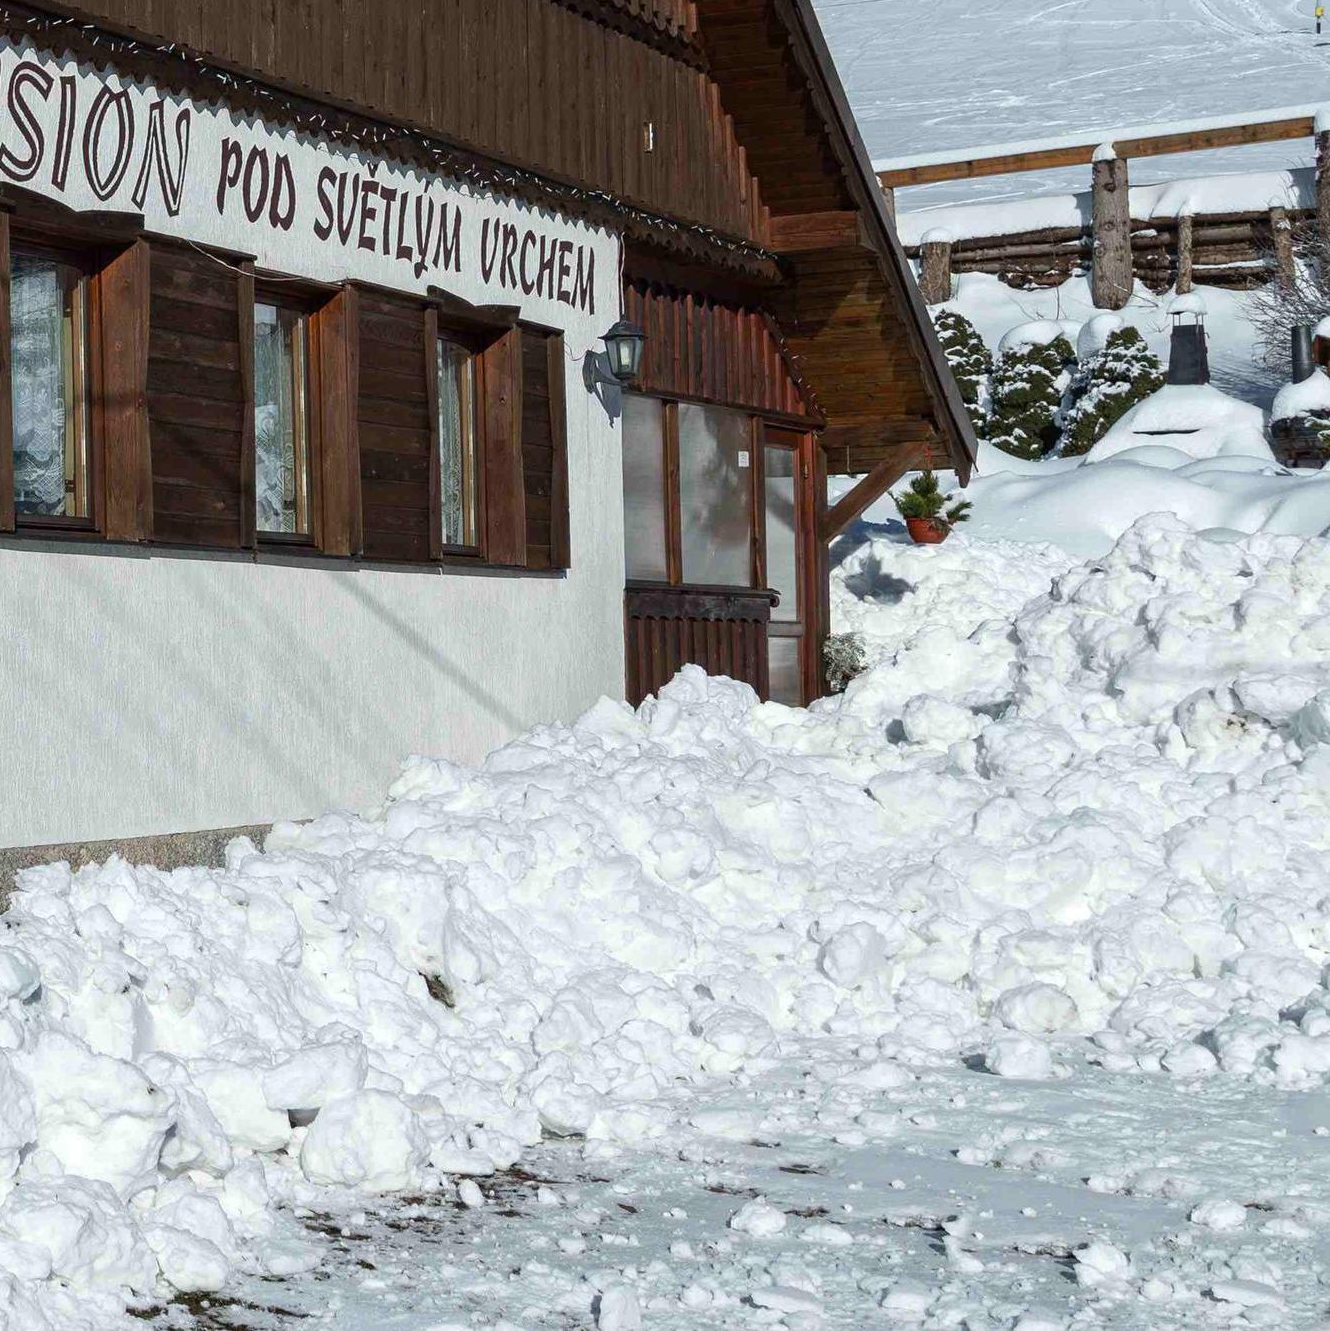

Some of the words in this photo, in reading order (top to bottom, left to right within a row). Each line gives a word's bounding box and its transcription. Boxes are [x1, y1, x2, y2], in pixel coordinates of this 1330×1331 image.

[216, 136, 297, 232] POD
[312, 162, 462, 279] SVĚTLÝM
[480, 217, 596, 316] VRCHEM
